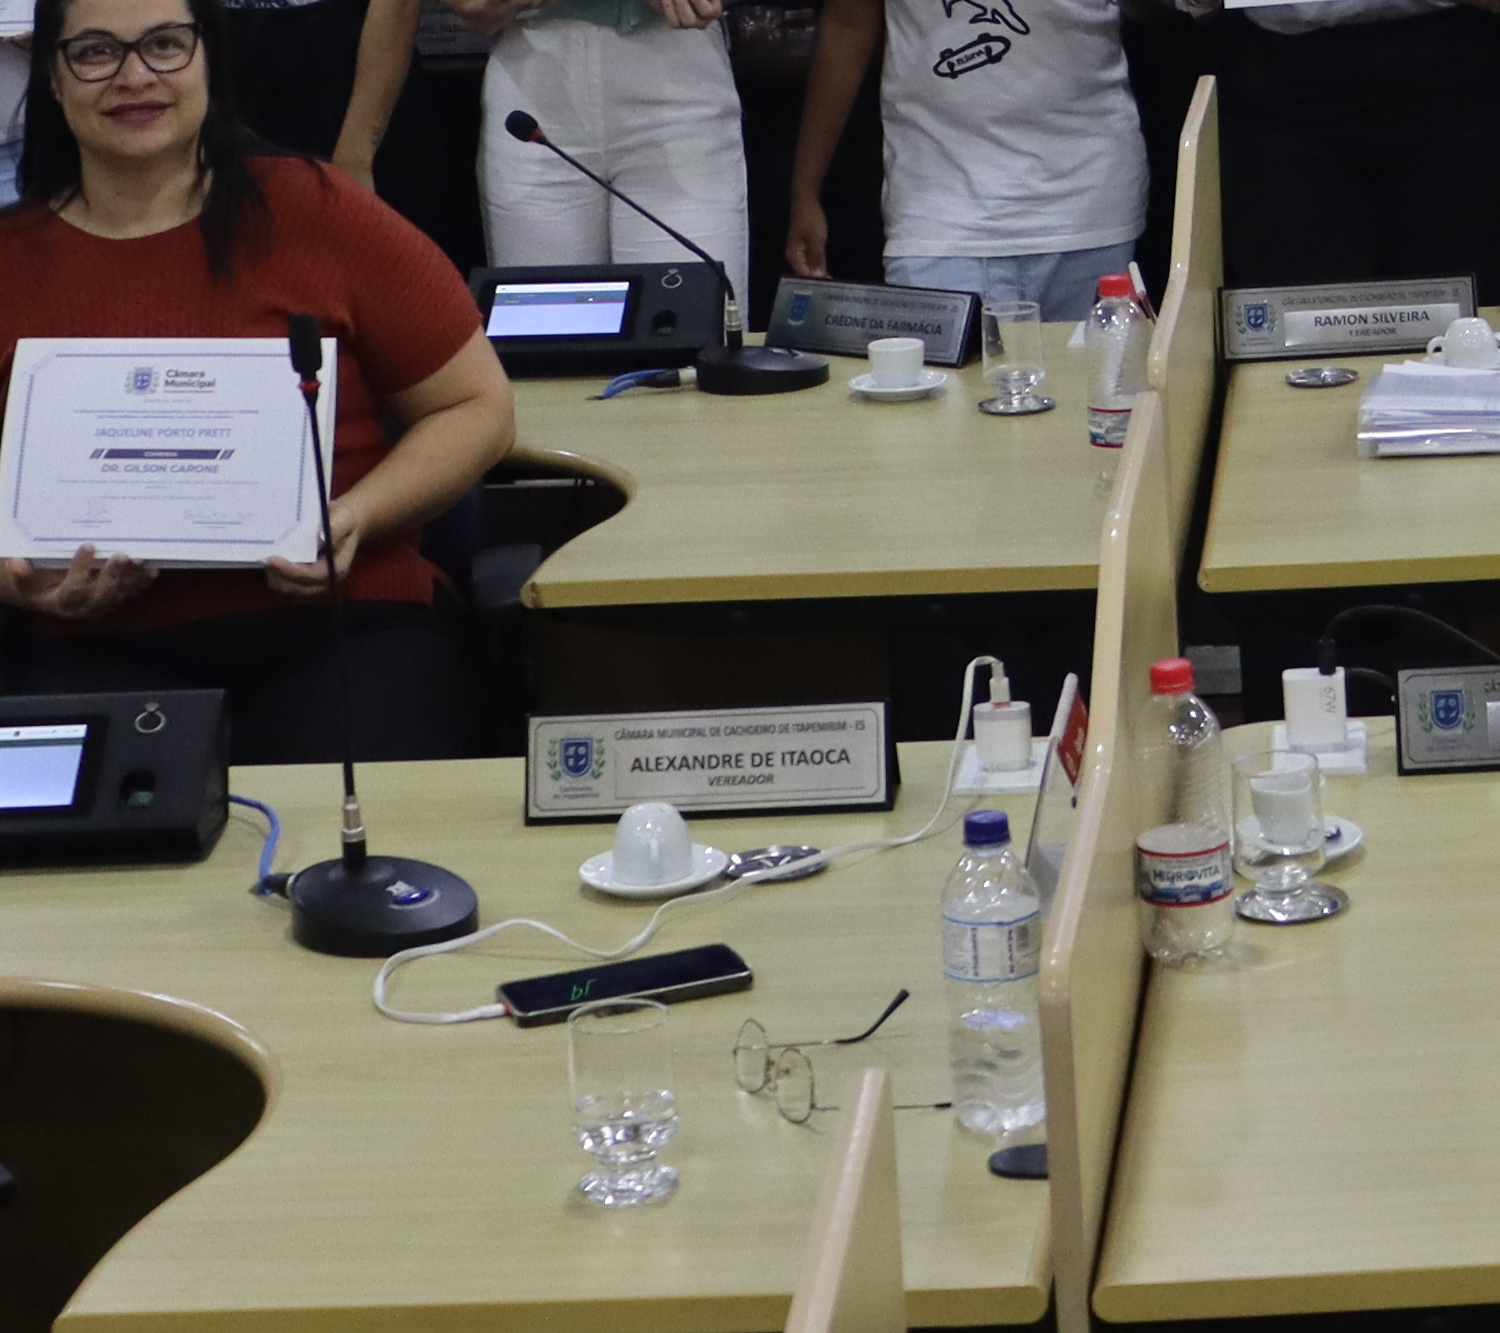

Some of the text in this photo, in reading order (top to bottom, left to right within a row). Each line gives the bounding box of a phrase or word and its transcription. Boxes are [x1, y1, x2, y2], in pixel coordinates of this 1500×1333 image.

[825, 314, 942, 335] CREONE DA FARMÁCIA
[1314, 310, 1430, 327] RAMON SILVEIRA
[165, 369, 205, 379] Câmara
[163, 379, 216, 389] Municipal
[124, 464, 167, 473] GILSON
[169, 464, 220, 474] CARONE
[630, 748, 850, 773] ALEXANDRE DE ITAOCA
[708, 773, 774, 786] VEREADOR
